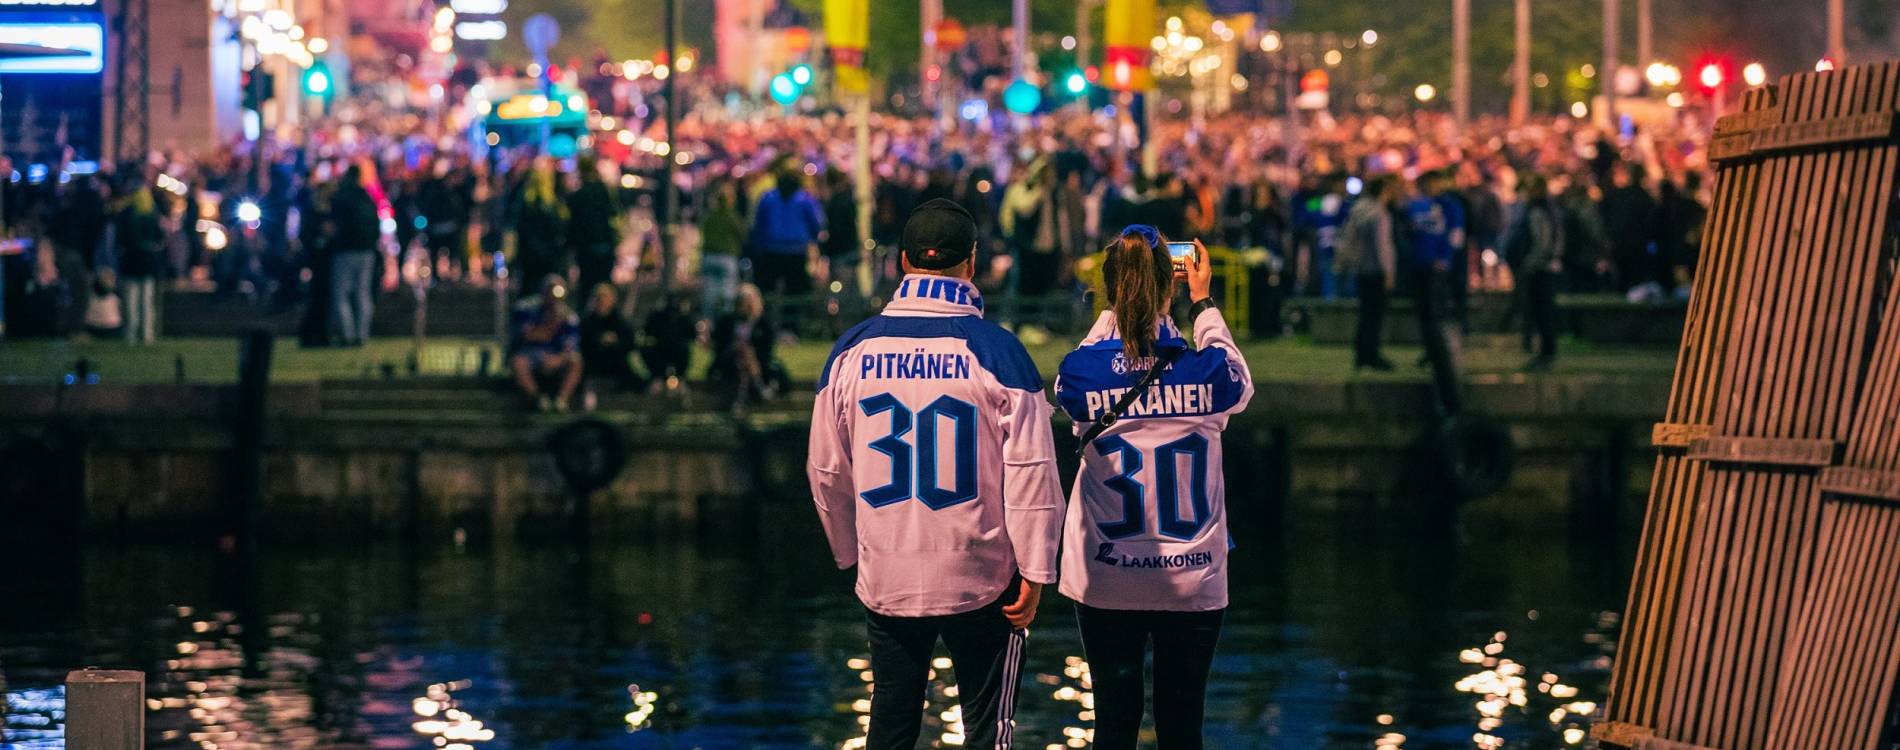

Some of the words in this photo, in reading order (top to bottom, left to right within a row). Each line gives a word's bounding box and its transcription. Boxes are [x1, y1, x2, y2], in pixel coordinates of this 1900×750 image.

[861, 348, 970, 380] PITKÄNEN
[858, 392, 978, 511] 30
[1091, 431, 1212, 541] 30
[1121, 551, 1212, 569] LAAKKONEN
